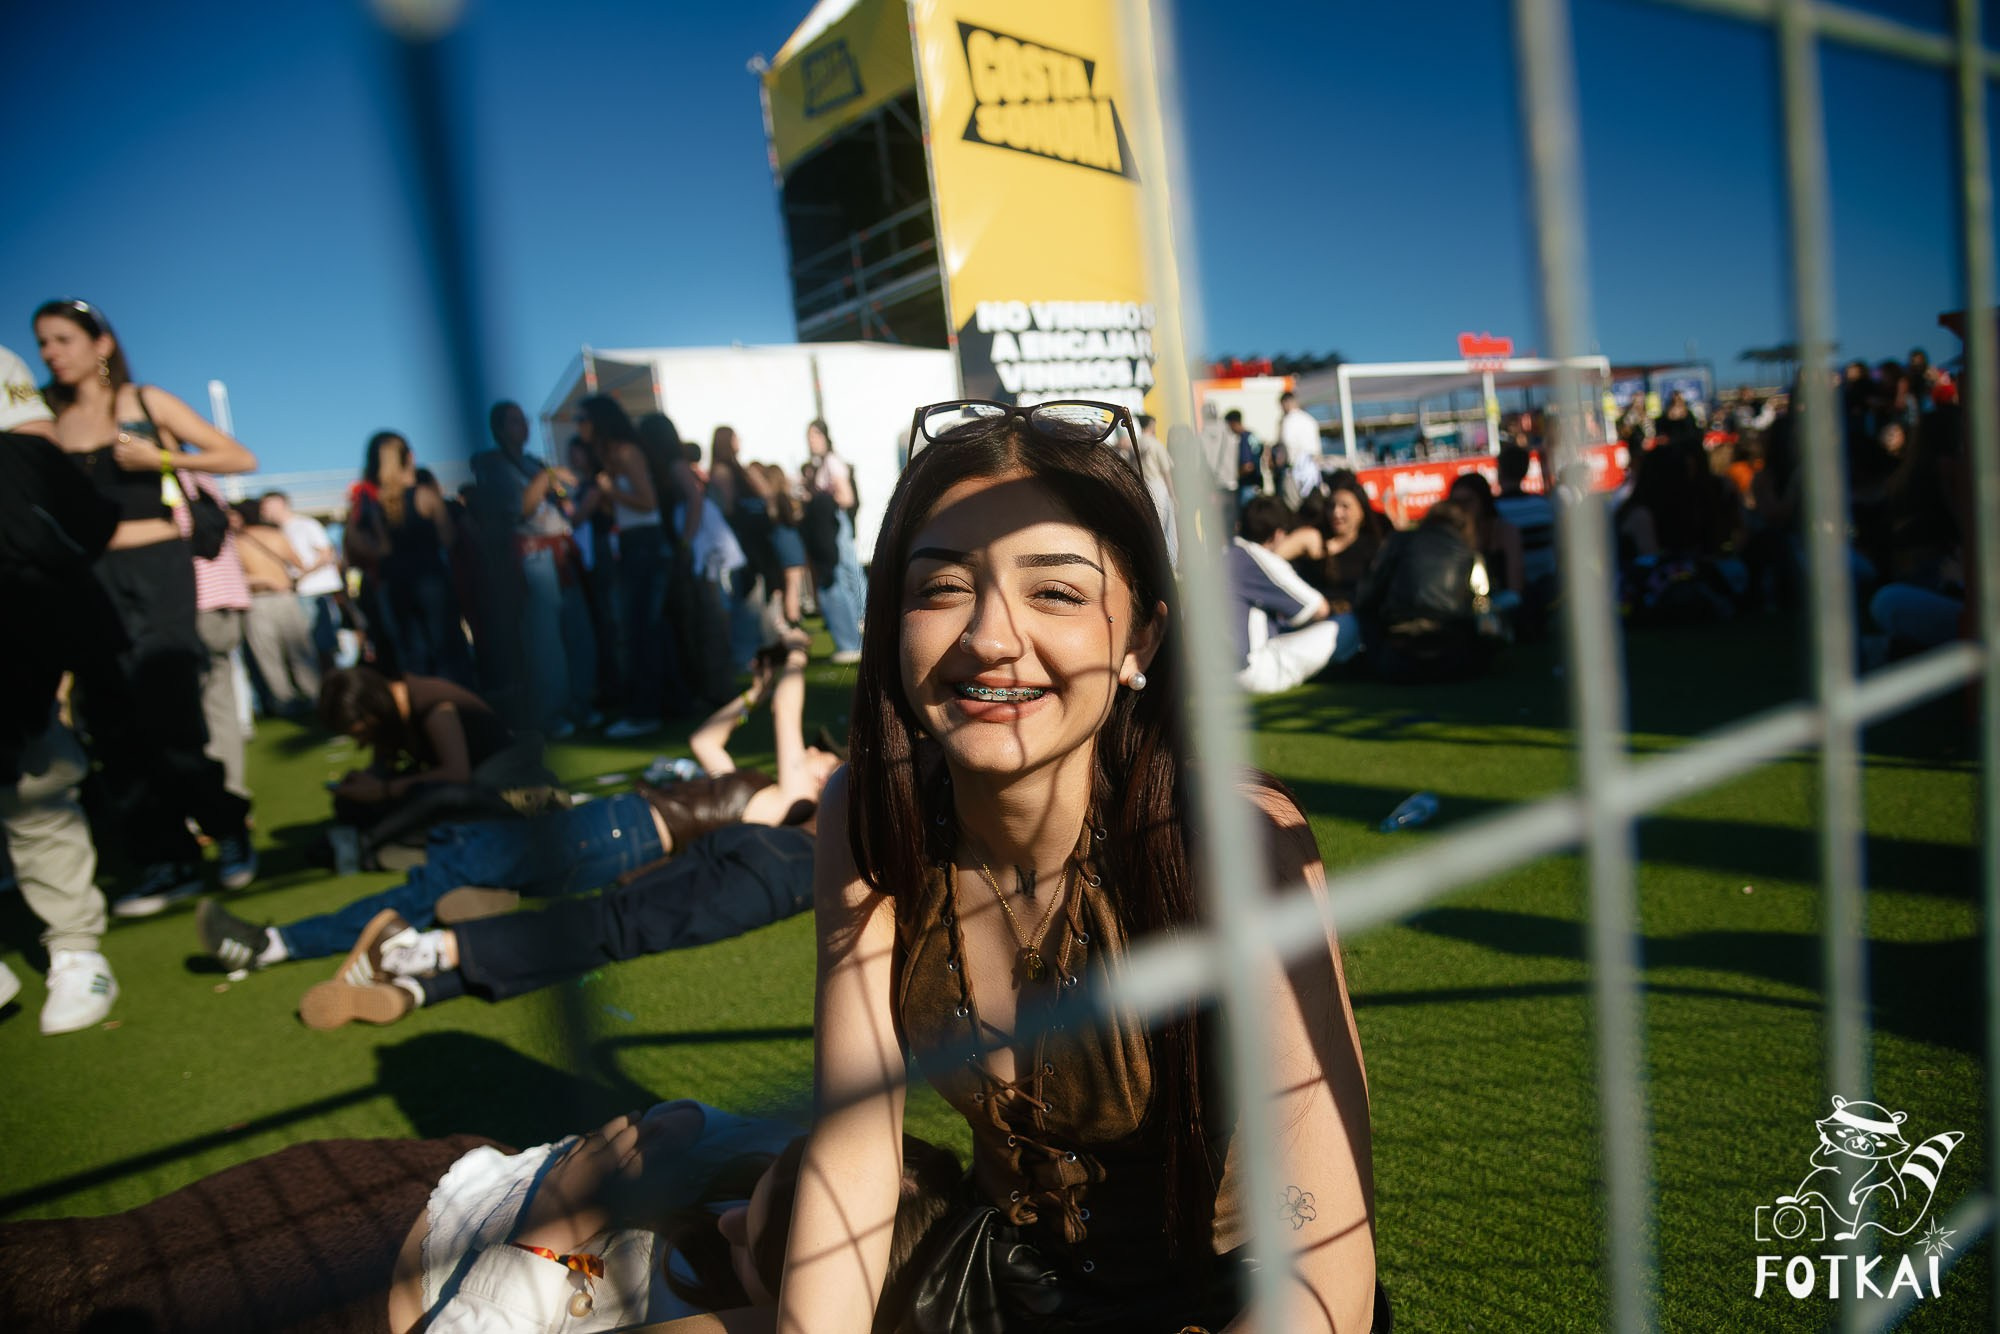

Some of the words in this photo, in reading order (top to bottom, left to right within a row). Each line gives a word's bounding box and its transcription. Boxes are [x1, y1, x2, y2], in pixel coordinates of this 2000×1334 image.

[976, 301, 1031, 332] NO
[992, 331, 1021, 363] A
[1134, 359, 1155, 386] A
